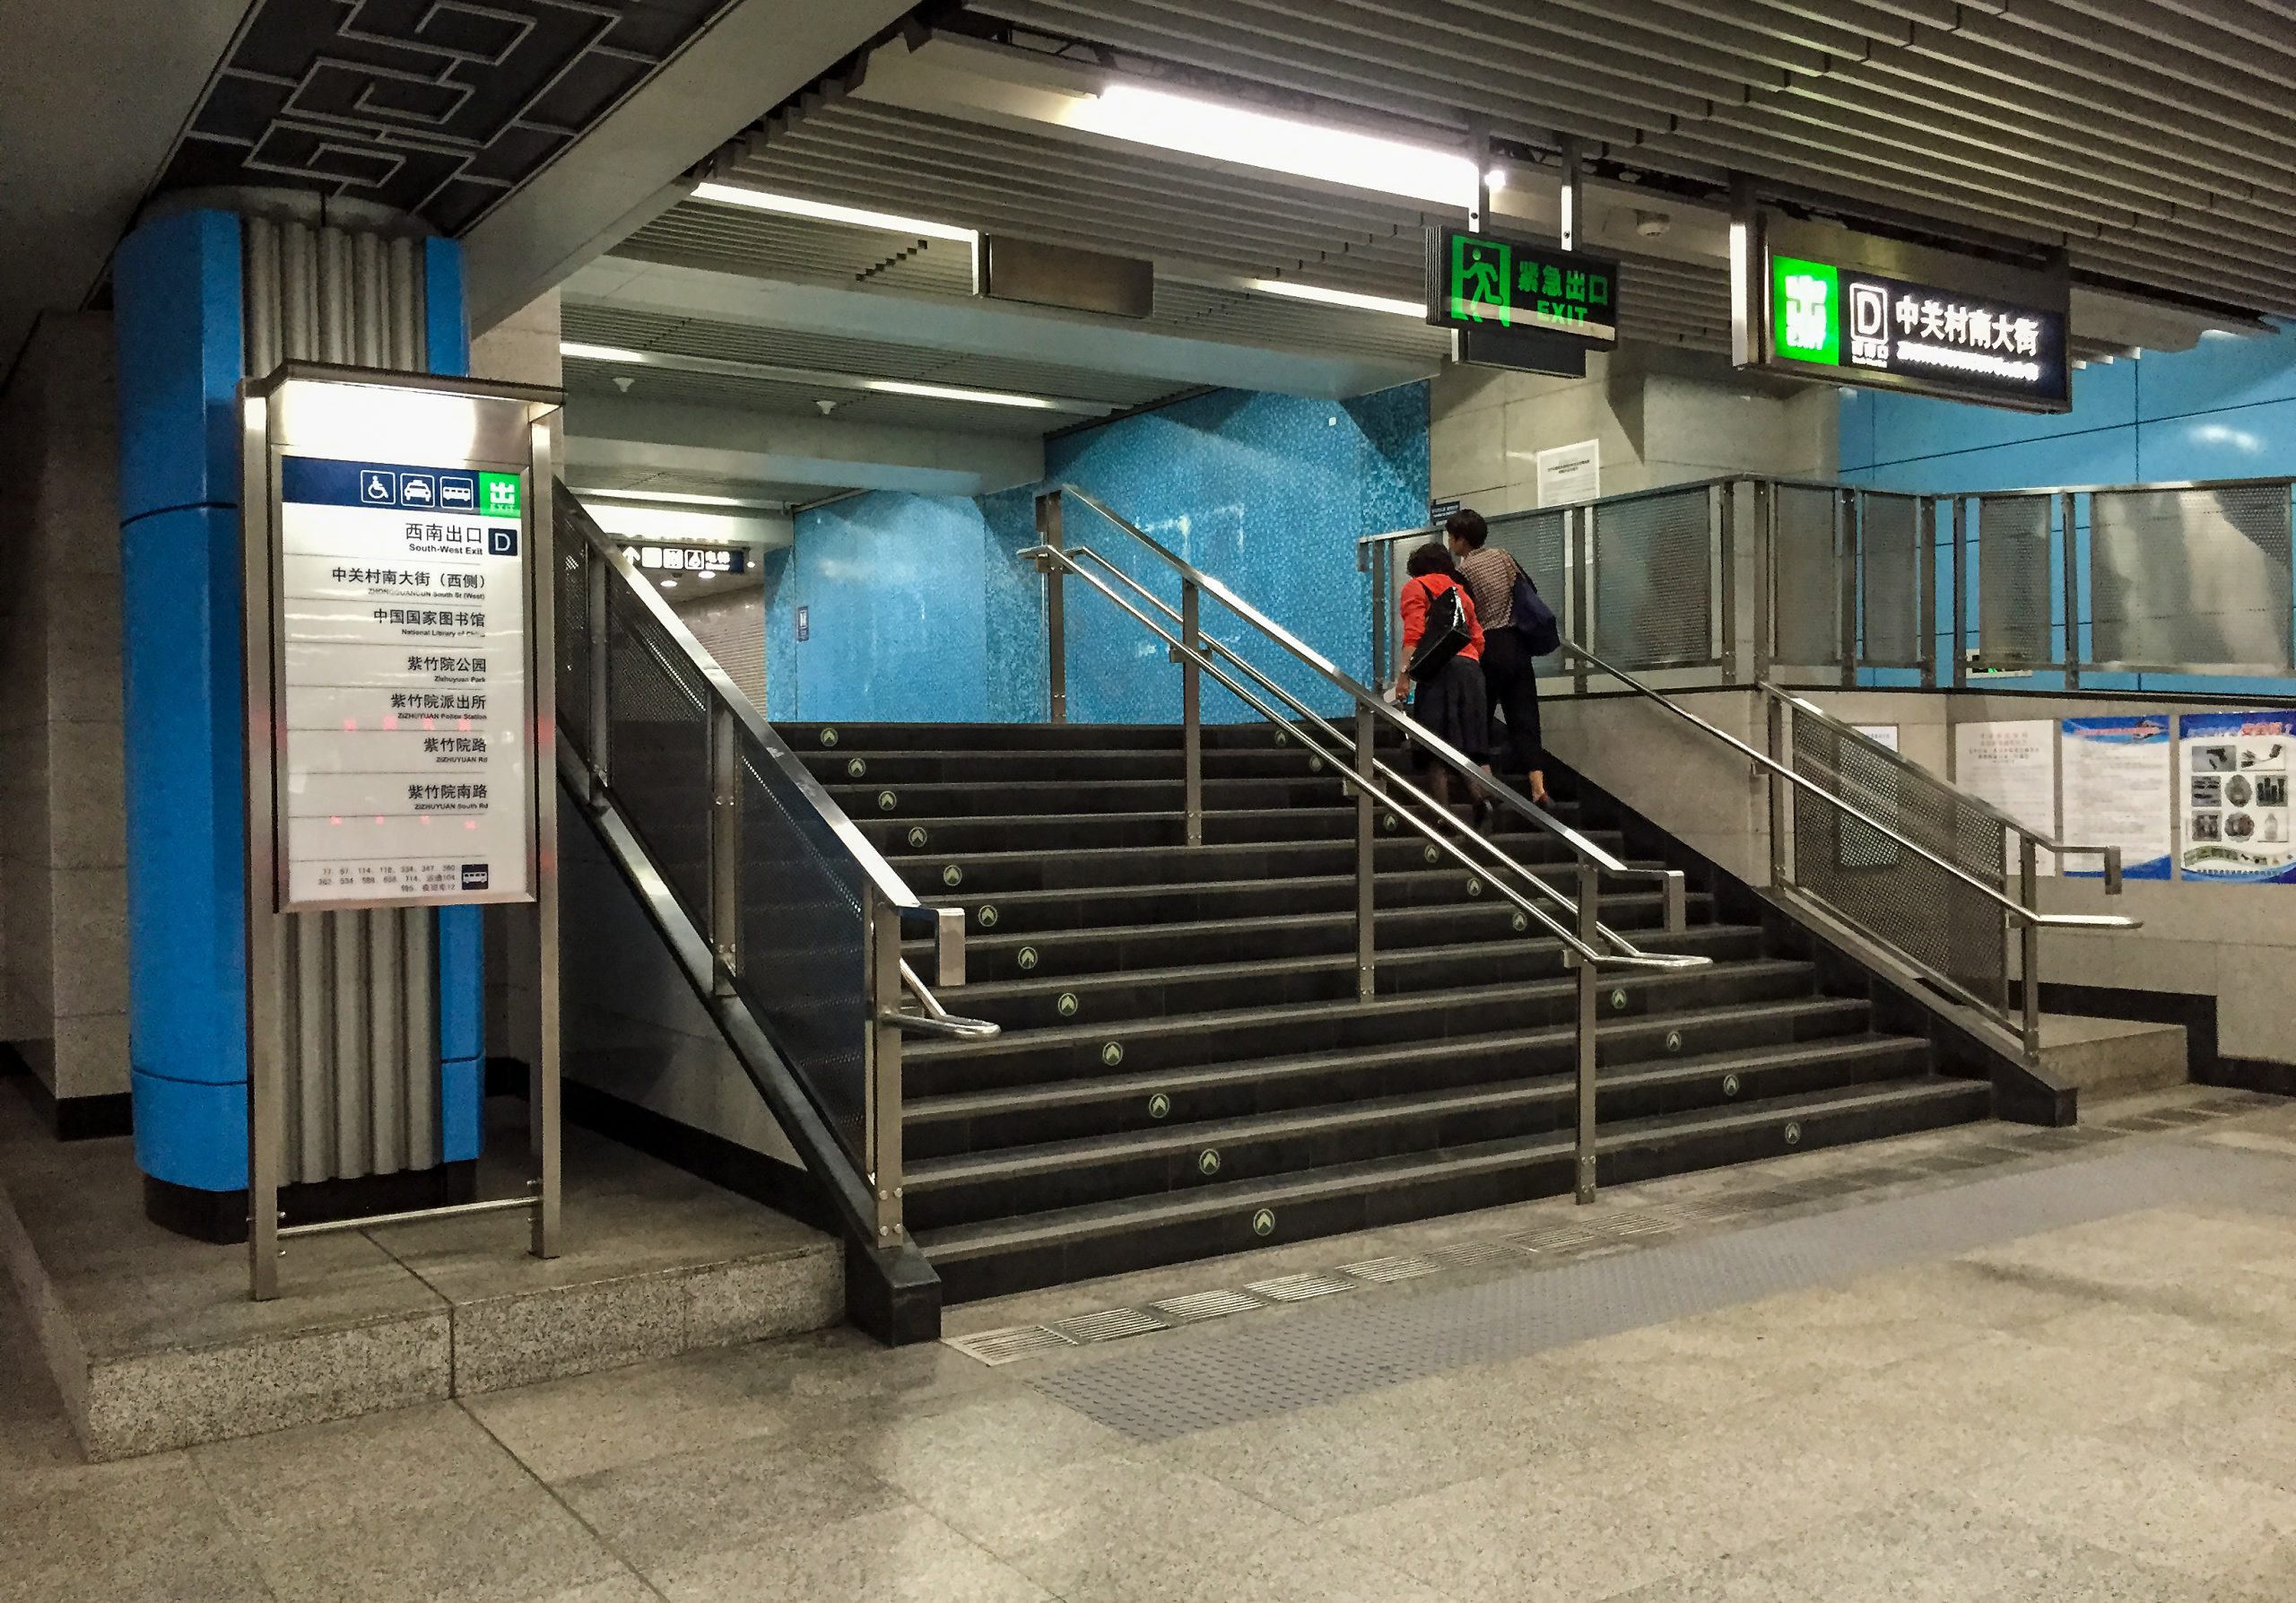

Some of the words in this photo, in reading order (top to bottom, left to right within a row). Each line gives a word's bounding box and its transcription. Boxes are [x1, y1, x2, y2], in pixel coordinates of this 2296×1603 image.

[1518, 260, 1608, 306] 紧急出口
[1537, 300, 1588, 327] EXIT
[1857, 291, 1882, 335] D
[1895, 295, 2039, 357] 中关村南大街
[490, 481, 515, 504] 出
[490, 503, 515, 512] EXIT
[405, 523, 482, 544] 西南出口
[494, 532, 511, 552] D
[409, 543, 463, 554] South-West
[465, 546, 483, 555] Exit
[373, 608, 485, 628] 中国国家图书馆
[431, 630, 456, 638] Library
[407, 656, 486, 673] 紫竹院公园
[391, 693, 486, 710] 紫竹院派出所
[423, 737, 487, 753] 紫竹院路
[408, 784, 488, 799] 紫竹院南路
